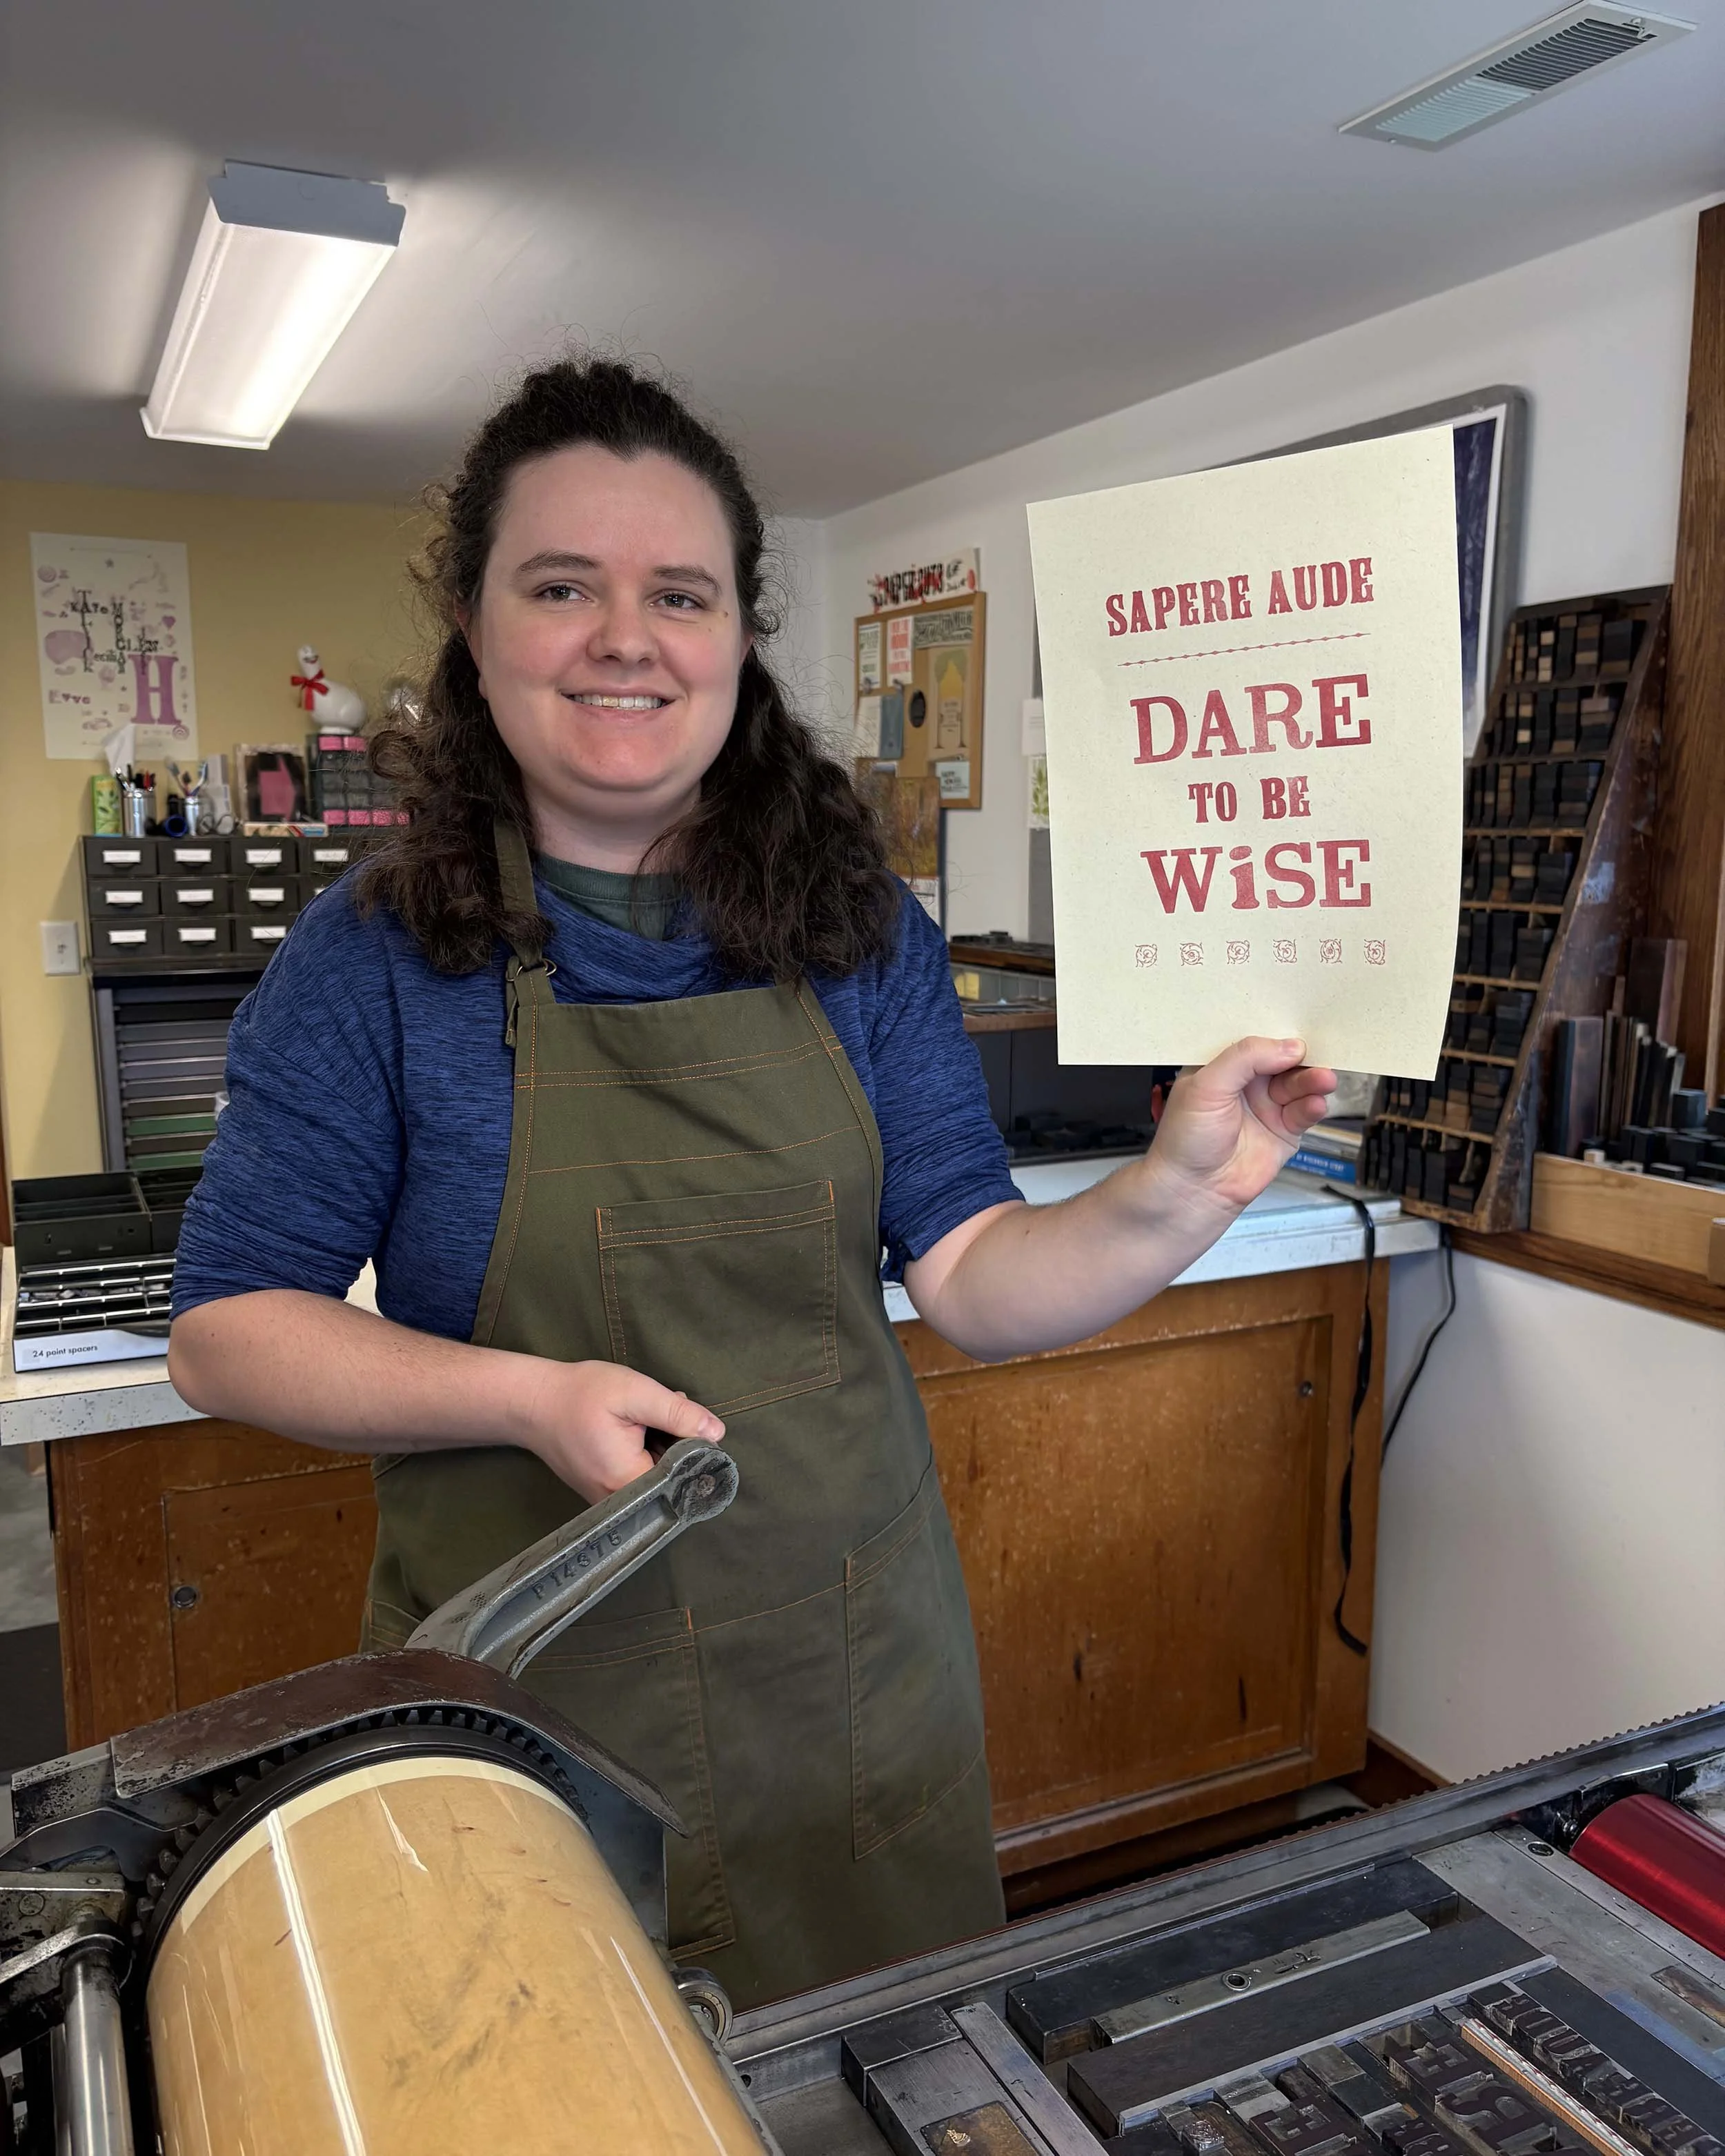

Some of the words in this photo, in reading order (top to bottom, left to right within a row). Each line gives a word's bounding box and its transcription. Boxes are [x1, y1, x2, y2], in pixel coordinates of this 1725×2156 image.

[1106, 575, 1251, 635] SAPERE
[1268, 558, 1373, 614] AUDE
[1130, 674, 1370, 764] DARE
[1188, 782, 1236, 823] TO
[1260, 777, 1310, 819] BE
[32, 1349, 44, 1358] 24
[46, 1347, 66, 1358] point
[68, 1345, 98, 1355] spacers
